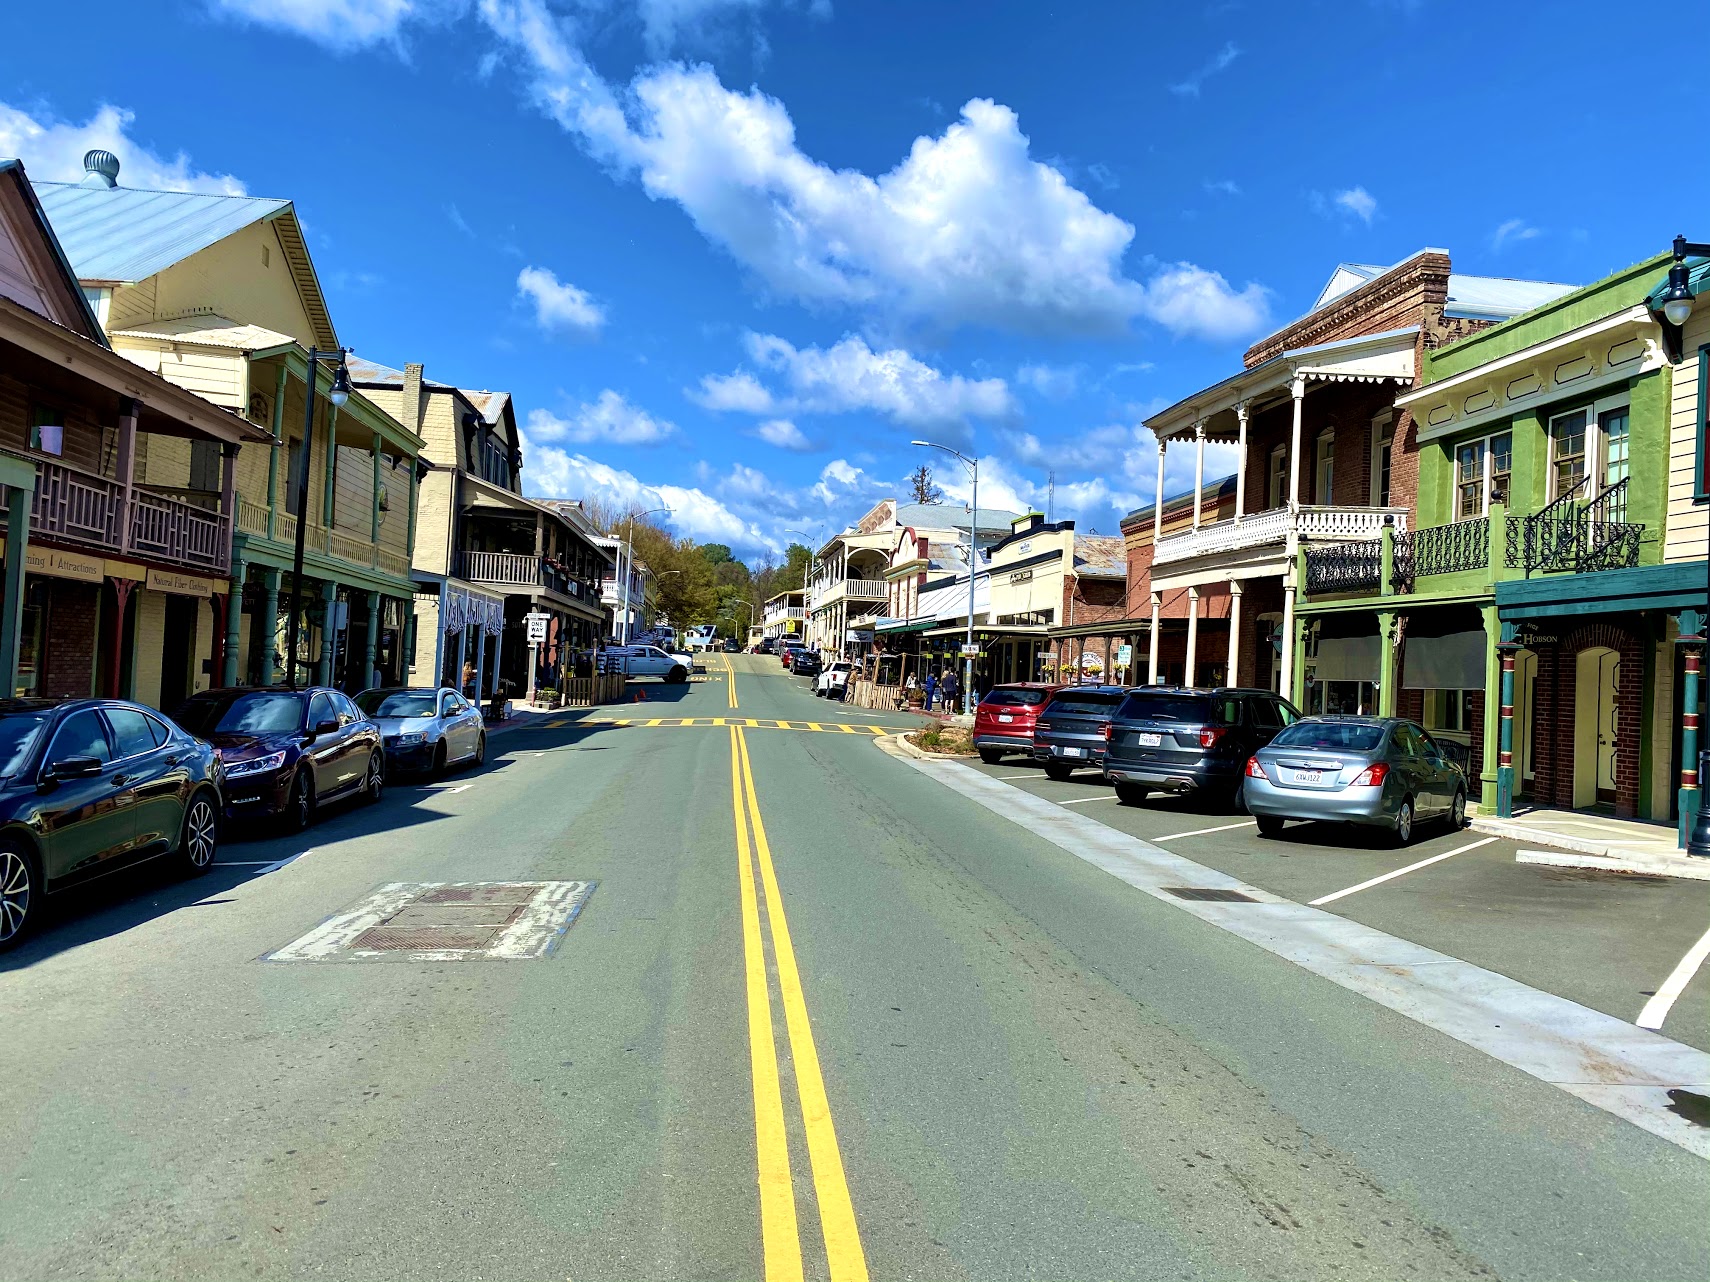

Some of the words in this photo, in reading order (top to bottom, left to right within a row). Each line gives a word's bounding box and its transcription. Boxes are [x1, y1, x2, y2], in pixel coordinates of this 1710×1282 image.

[57, 557, 97, 575] Attractions
[153, 574, 173, 587] Natural
[174, 576, 187, 589] Fiber
[188, 579, 208, 593] Clothing
[1523, 633, 1558, 645] HOBSON
